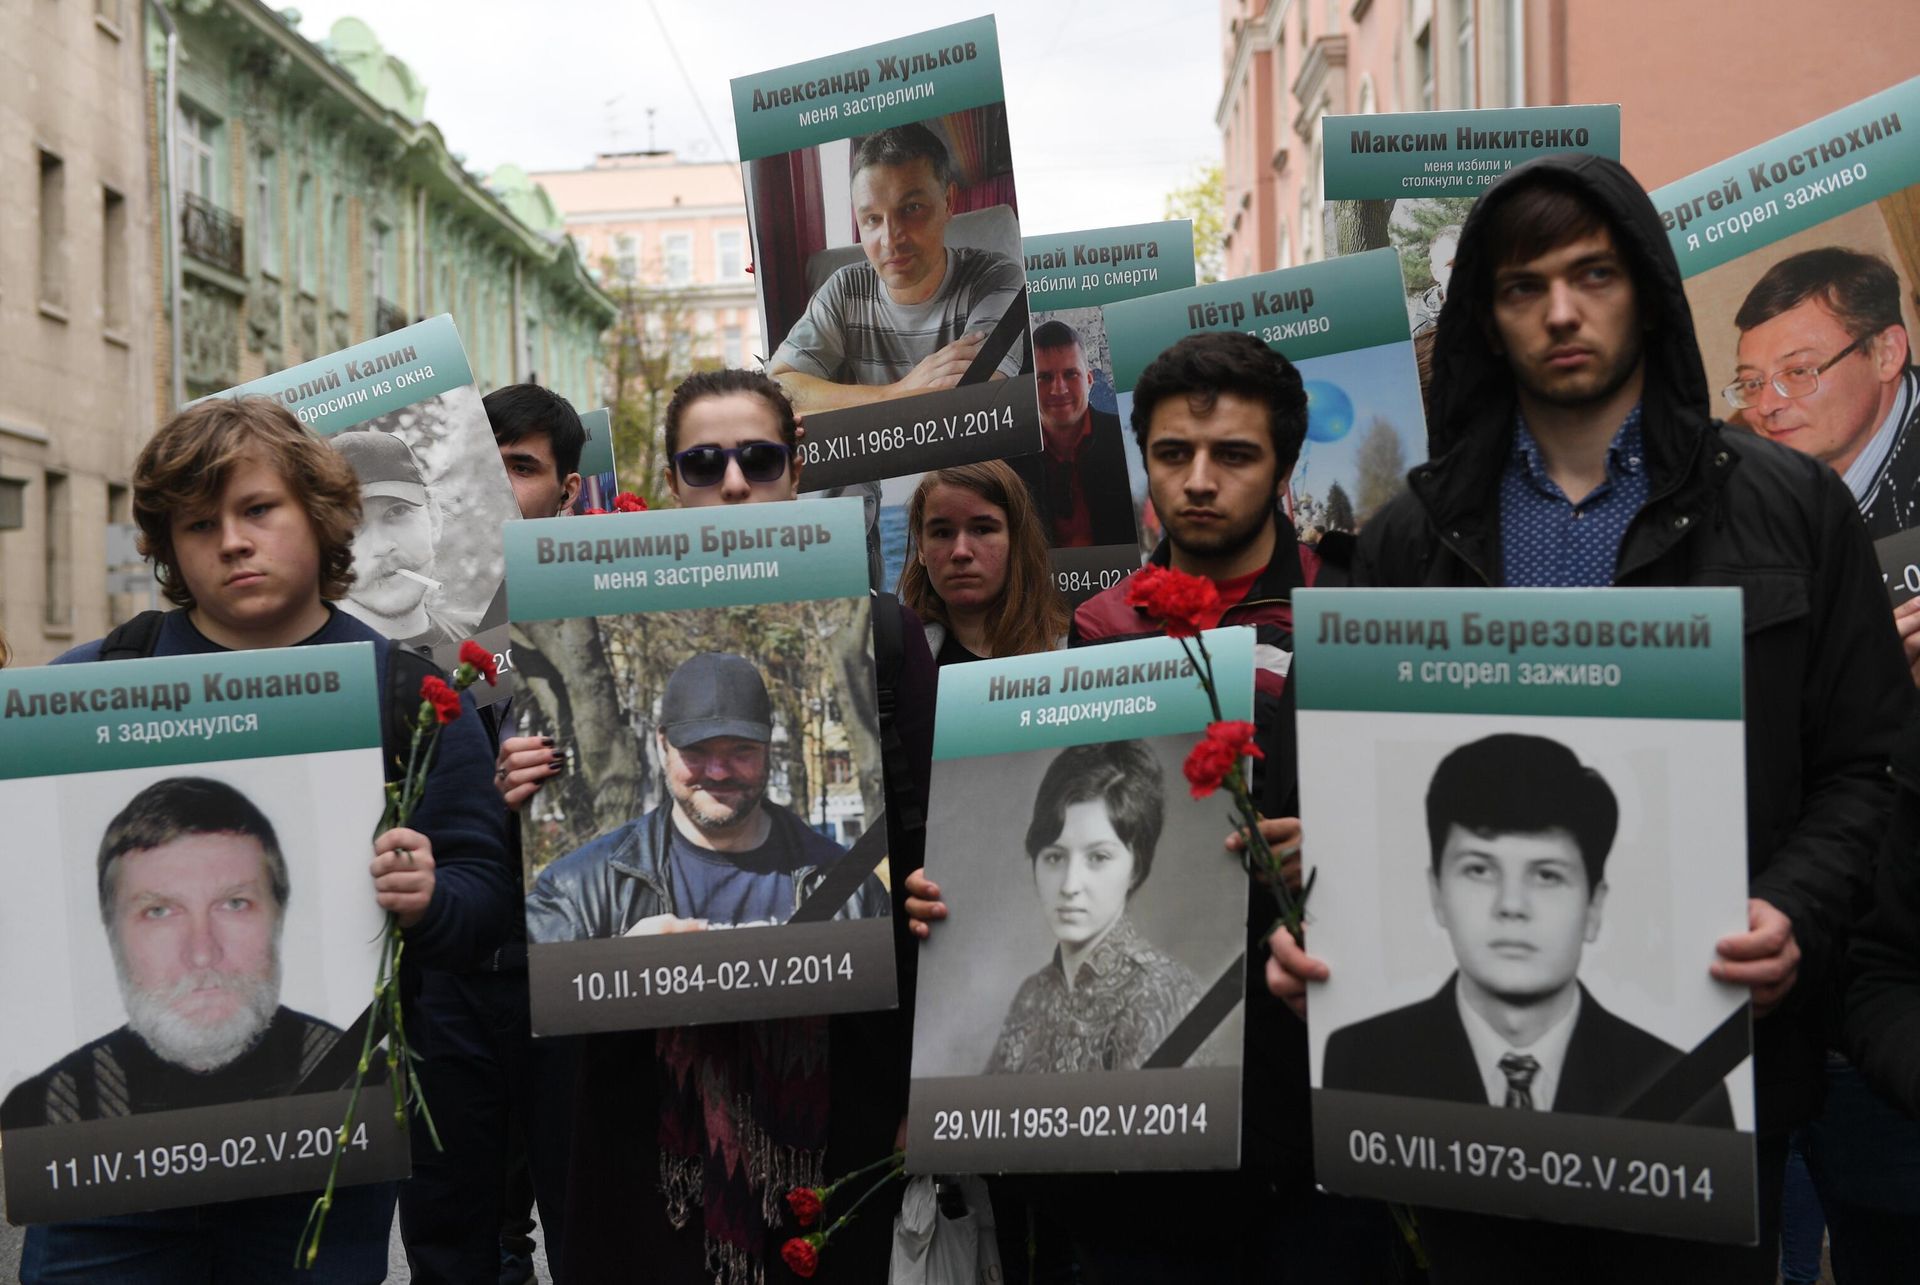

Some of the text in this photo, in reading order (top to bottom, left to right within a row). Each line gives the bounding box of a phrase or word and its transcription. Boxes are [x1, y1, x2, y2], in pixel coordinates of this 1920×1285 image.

[752, 41, 978, 112] Александр Жульков
[799, 81, 935, 127] меня застрелили
[1350, 127, 1589, 154] Максим Никитенко
[1402, 174, 1463, 188] столкнули
[1466, 175, 1473, 186] с
[1424, 158, 1512, 173] меня избили и
[1659, 112, 1902, 232] ергей Костюхин
[1686, 163, 1868, 252] я сгорел заживо
[1073, 240, 1159, 268] Коврига
[1081, 274, 1100, 292] до
[1104, 266, 1159, 288] смерти
[1187, 287, 1315, 330] Пётр Каир
[1262, 316, 1331, 344] заживо
[272, 345, 418, 406] толий Калин
[294, 364, 436, 424] бросили из окна
[796, 405, 1015, 466] 08.XII.1968-02.V.2014
[536, 523, 832, 565] Владимир Брыгарь
[593, 560, 780, 590] меня застрелили
[1317, 611, 1712, 655] Леонид Березовский
[4, 670, 341, 718] Александр Конанов
[989, 656, 1196, 702] Нина Ломакина
[1398, 659, 1621, 689] я сгорел заживо
[97, 713, 259, 744] я задохнулся
[1020, 695, 1157, 728] я задохнулась
[571, 952, 854, 1002] 10.II.1984-02.V.2014
[933, 1102, 1208, 1141] 29.VII.1953-02.V.2014
[1348, 1129, 1714, 1203] 06.VII.1973-02.V.2014
